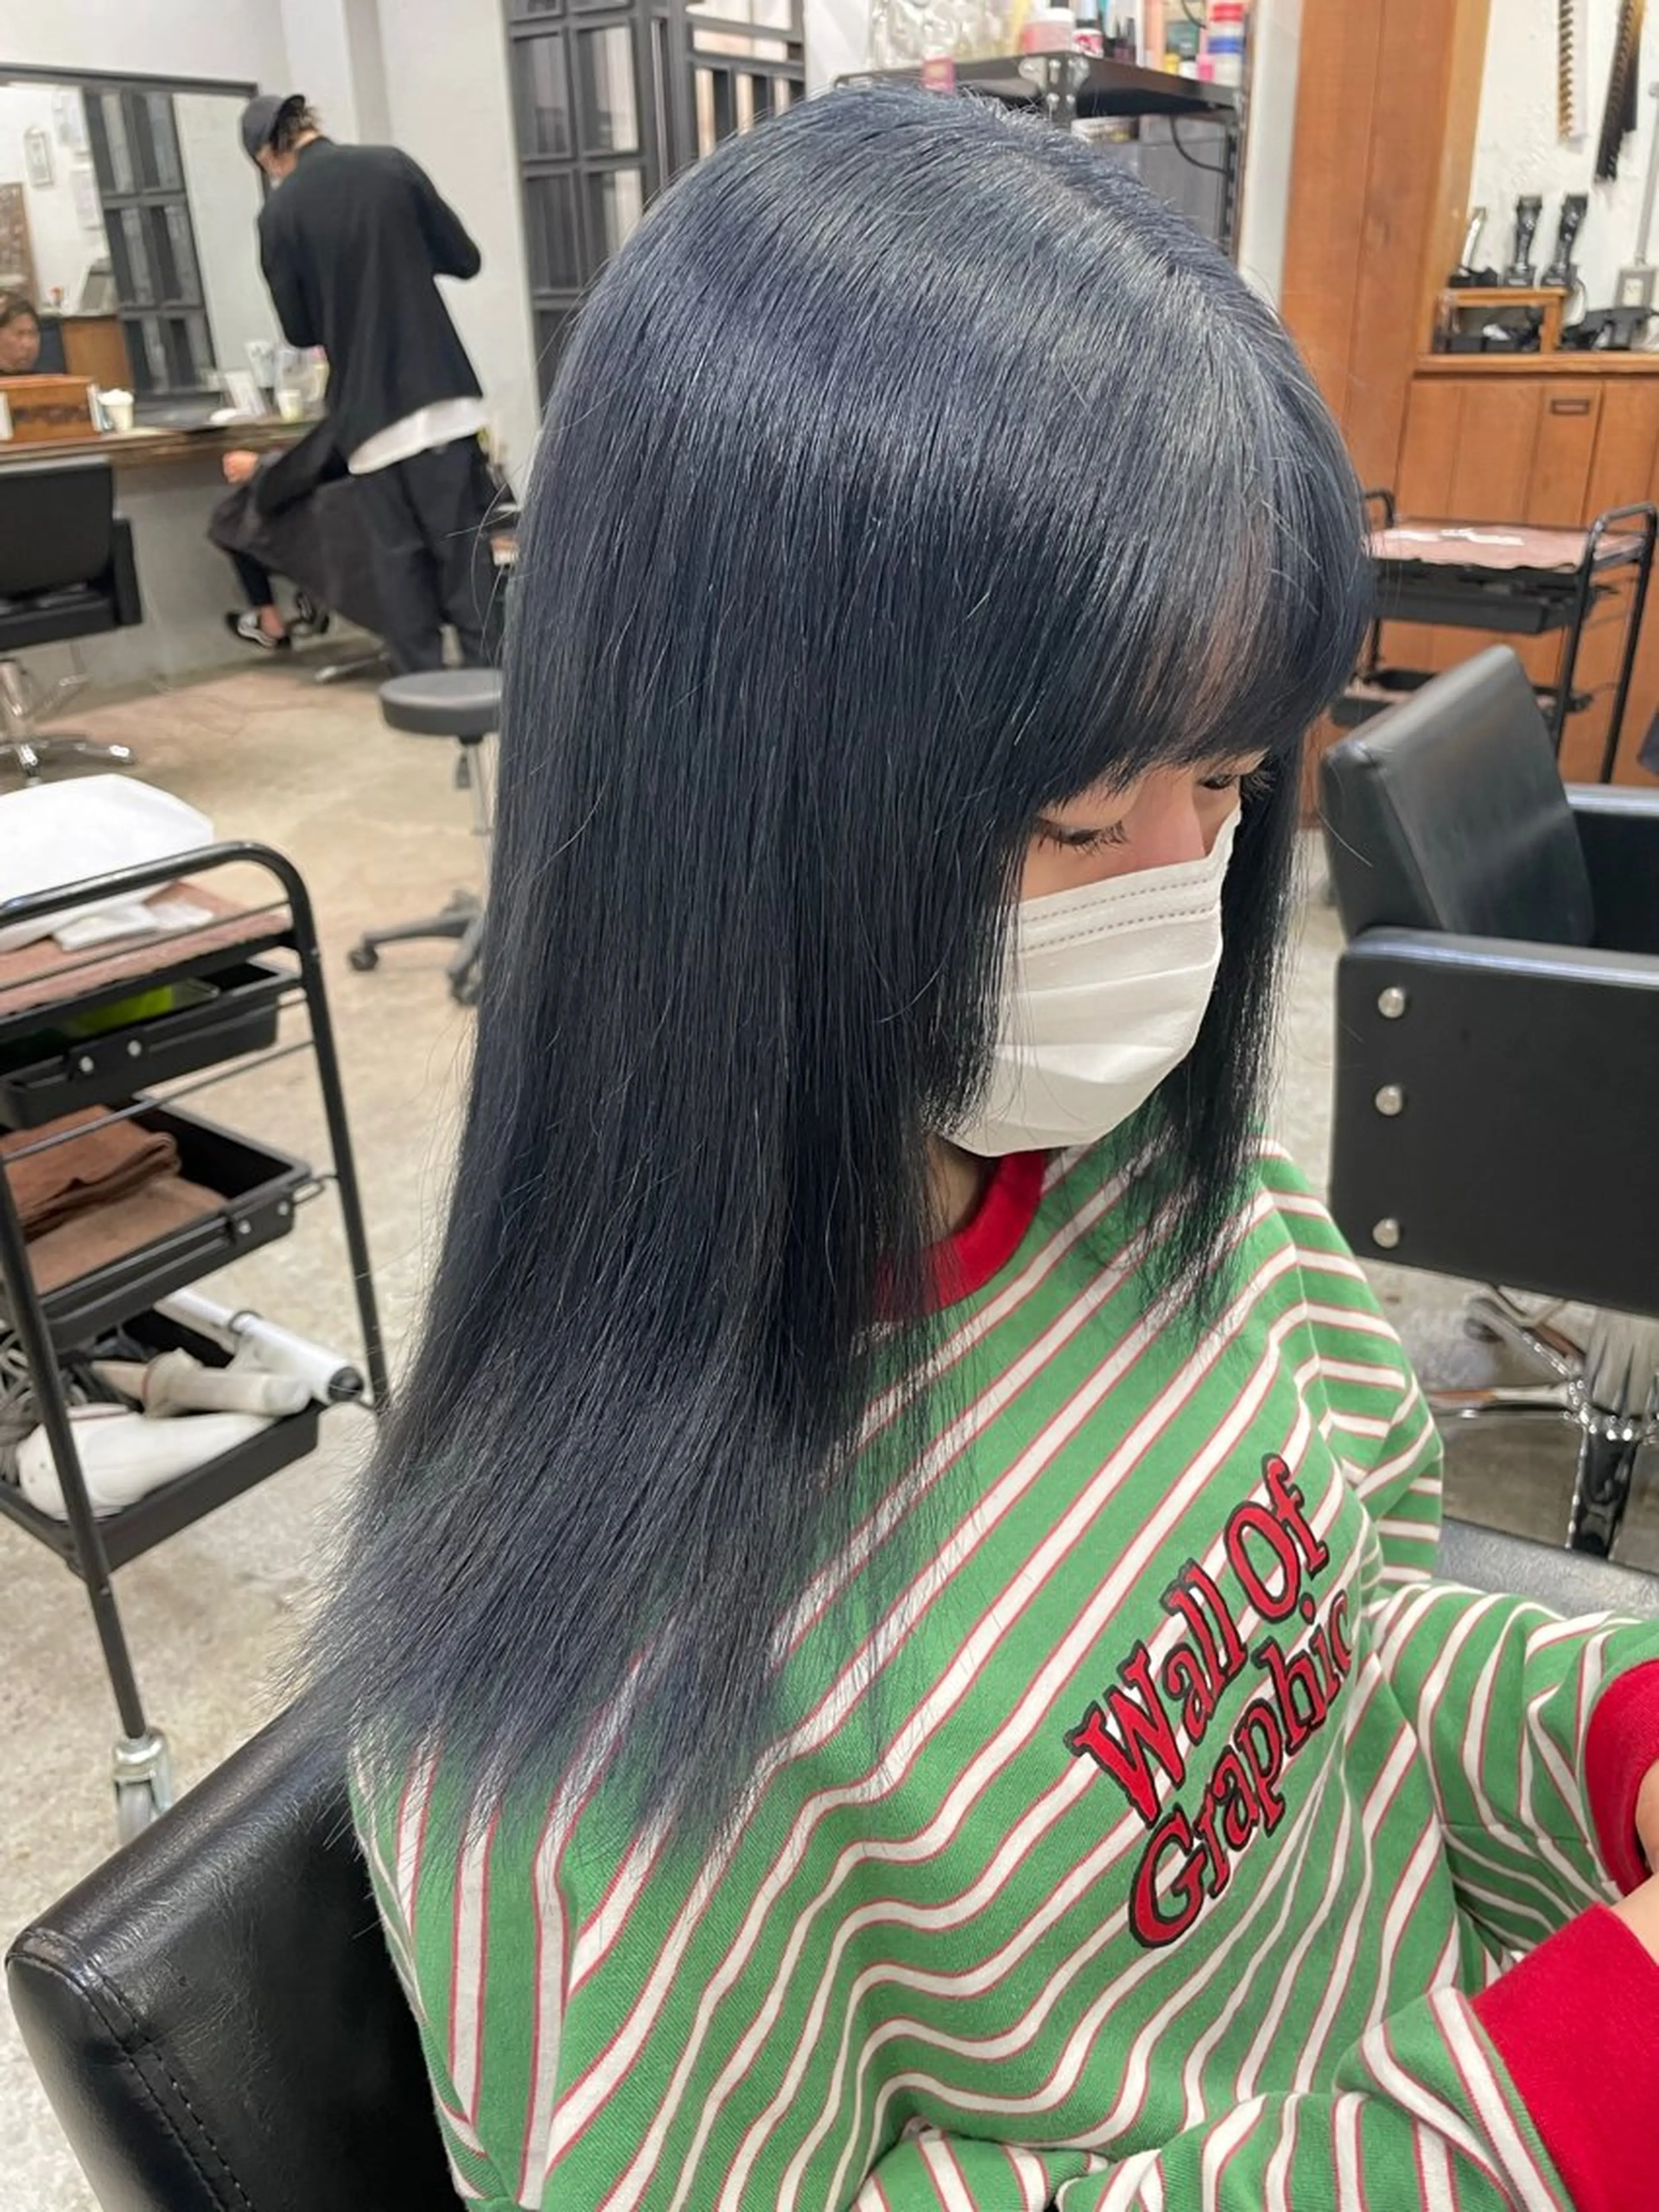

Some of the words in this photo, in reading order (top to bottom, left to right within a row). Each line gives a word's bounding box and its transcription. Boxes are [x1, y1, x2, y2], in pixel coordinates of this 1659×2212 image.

[1064, 1558, 1247, 1830] Wall
[1224, 1452, 1329, 1624] Of
[1128, 1589, 1351, 1949] Graphic
